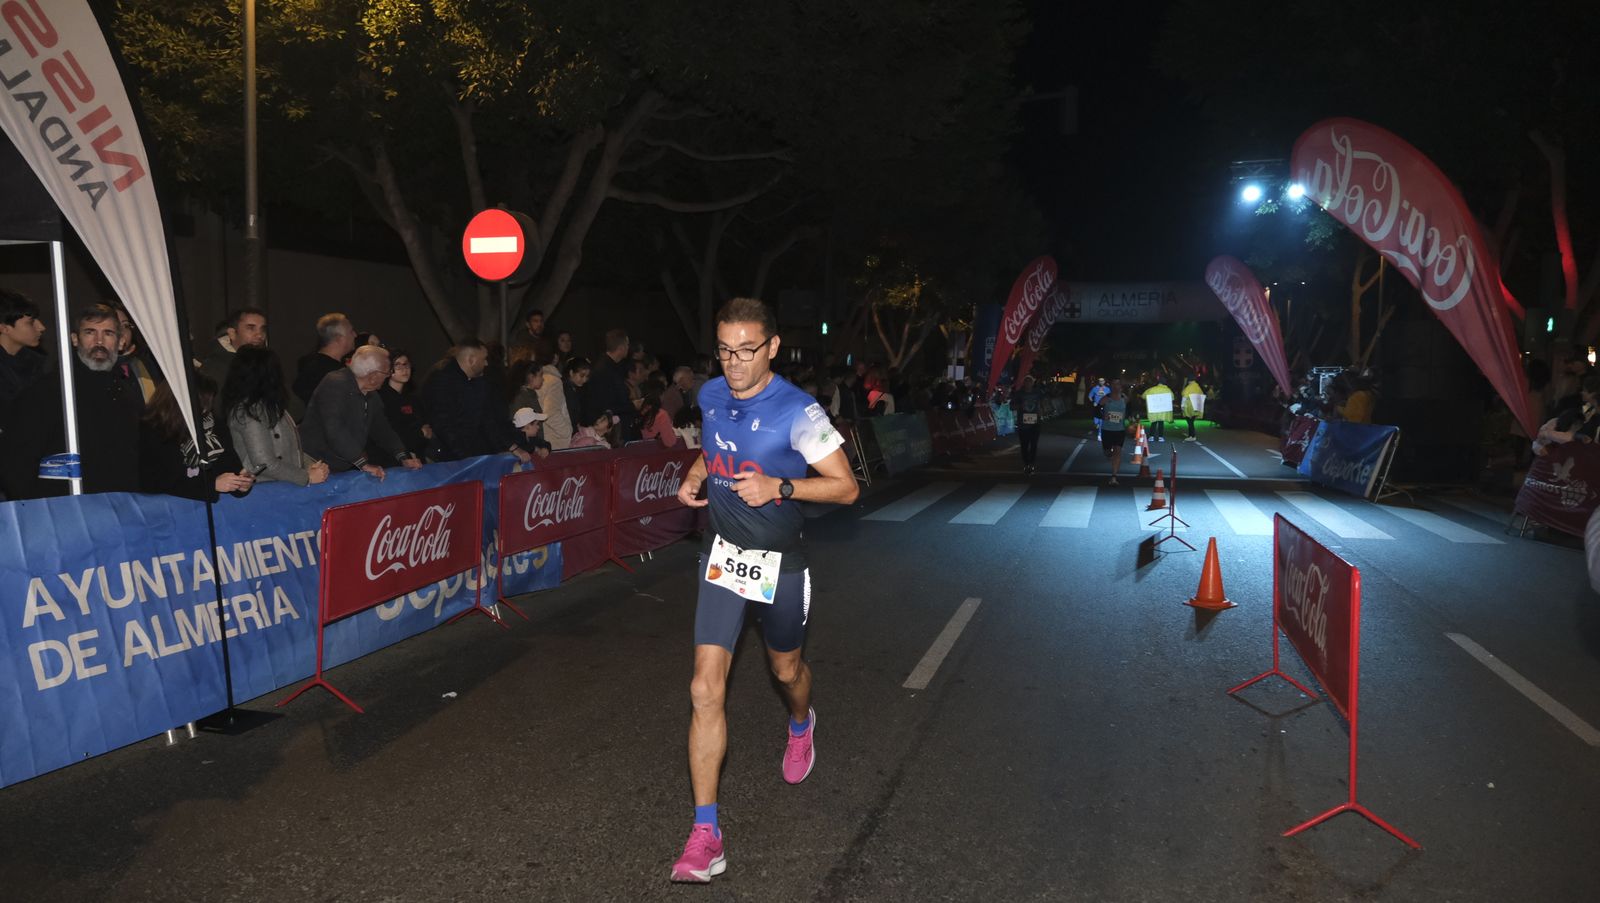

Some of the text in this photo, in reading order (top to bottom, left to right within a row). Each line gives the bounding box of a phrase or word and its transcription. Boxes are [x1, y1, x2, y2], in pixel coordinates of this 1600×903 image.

[1005, 260, 1055, 345] Coca-Cola
[524, 475, 588, 532] Coca-Cola
[635, 461, 684, 503] Coca-Cola
[22, 529, 322, 628] AYUNTAMIENT
[365, 502, 456, 581] Coca-Cola
[724, 557, 762, 581] 586
[28, 581, 300, 691] DE ALMERÍA
[1284, 545, 1330, 655] Coca-Cola
